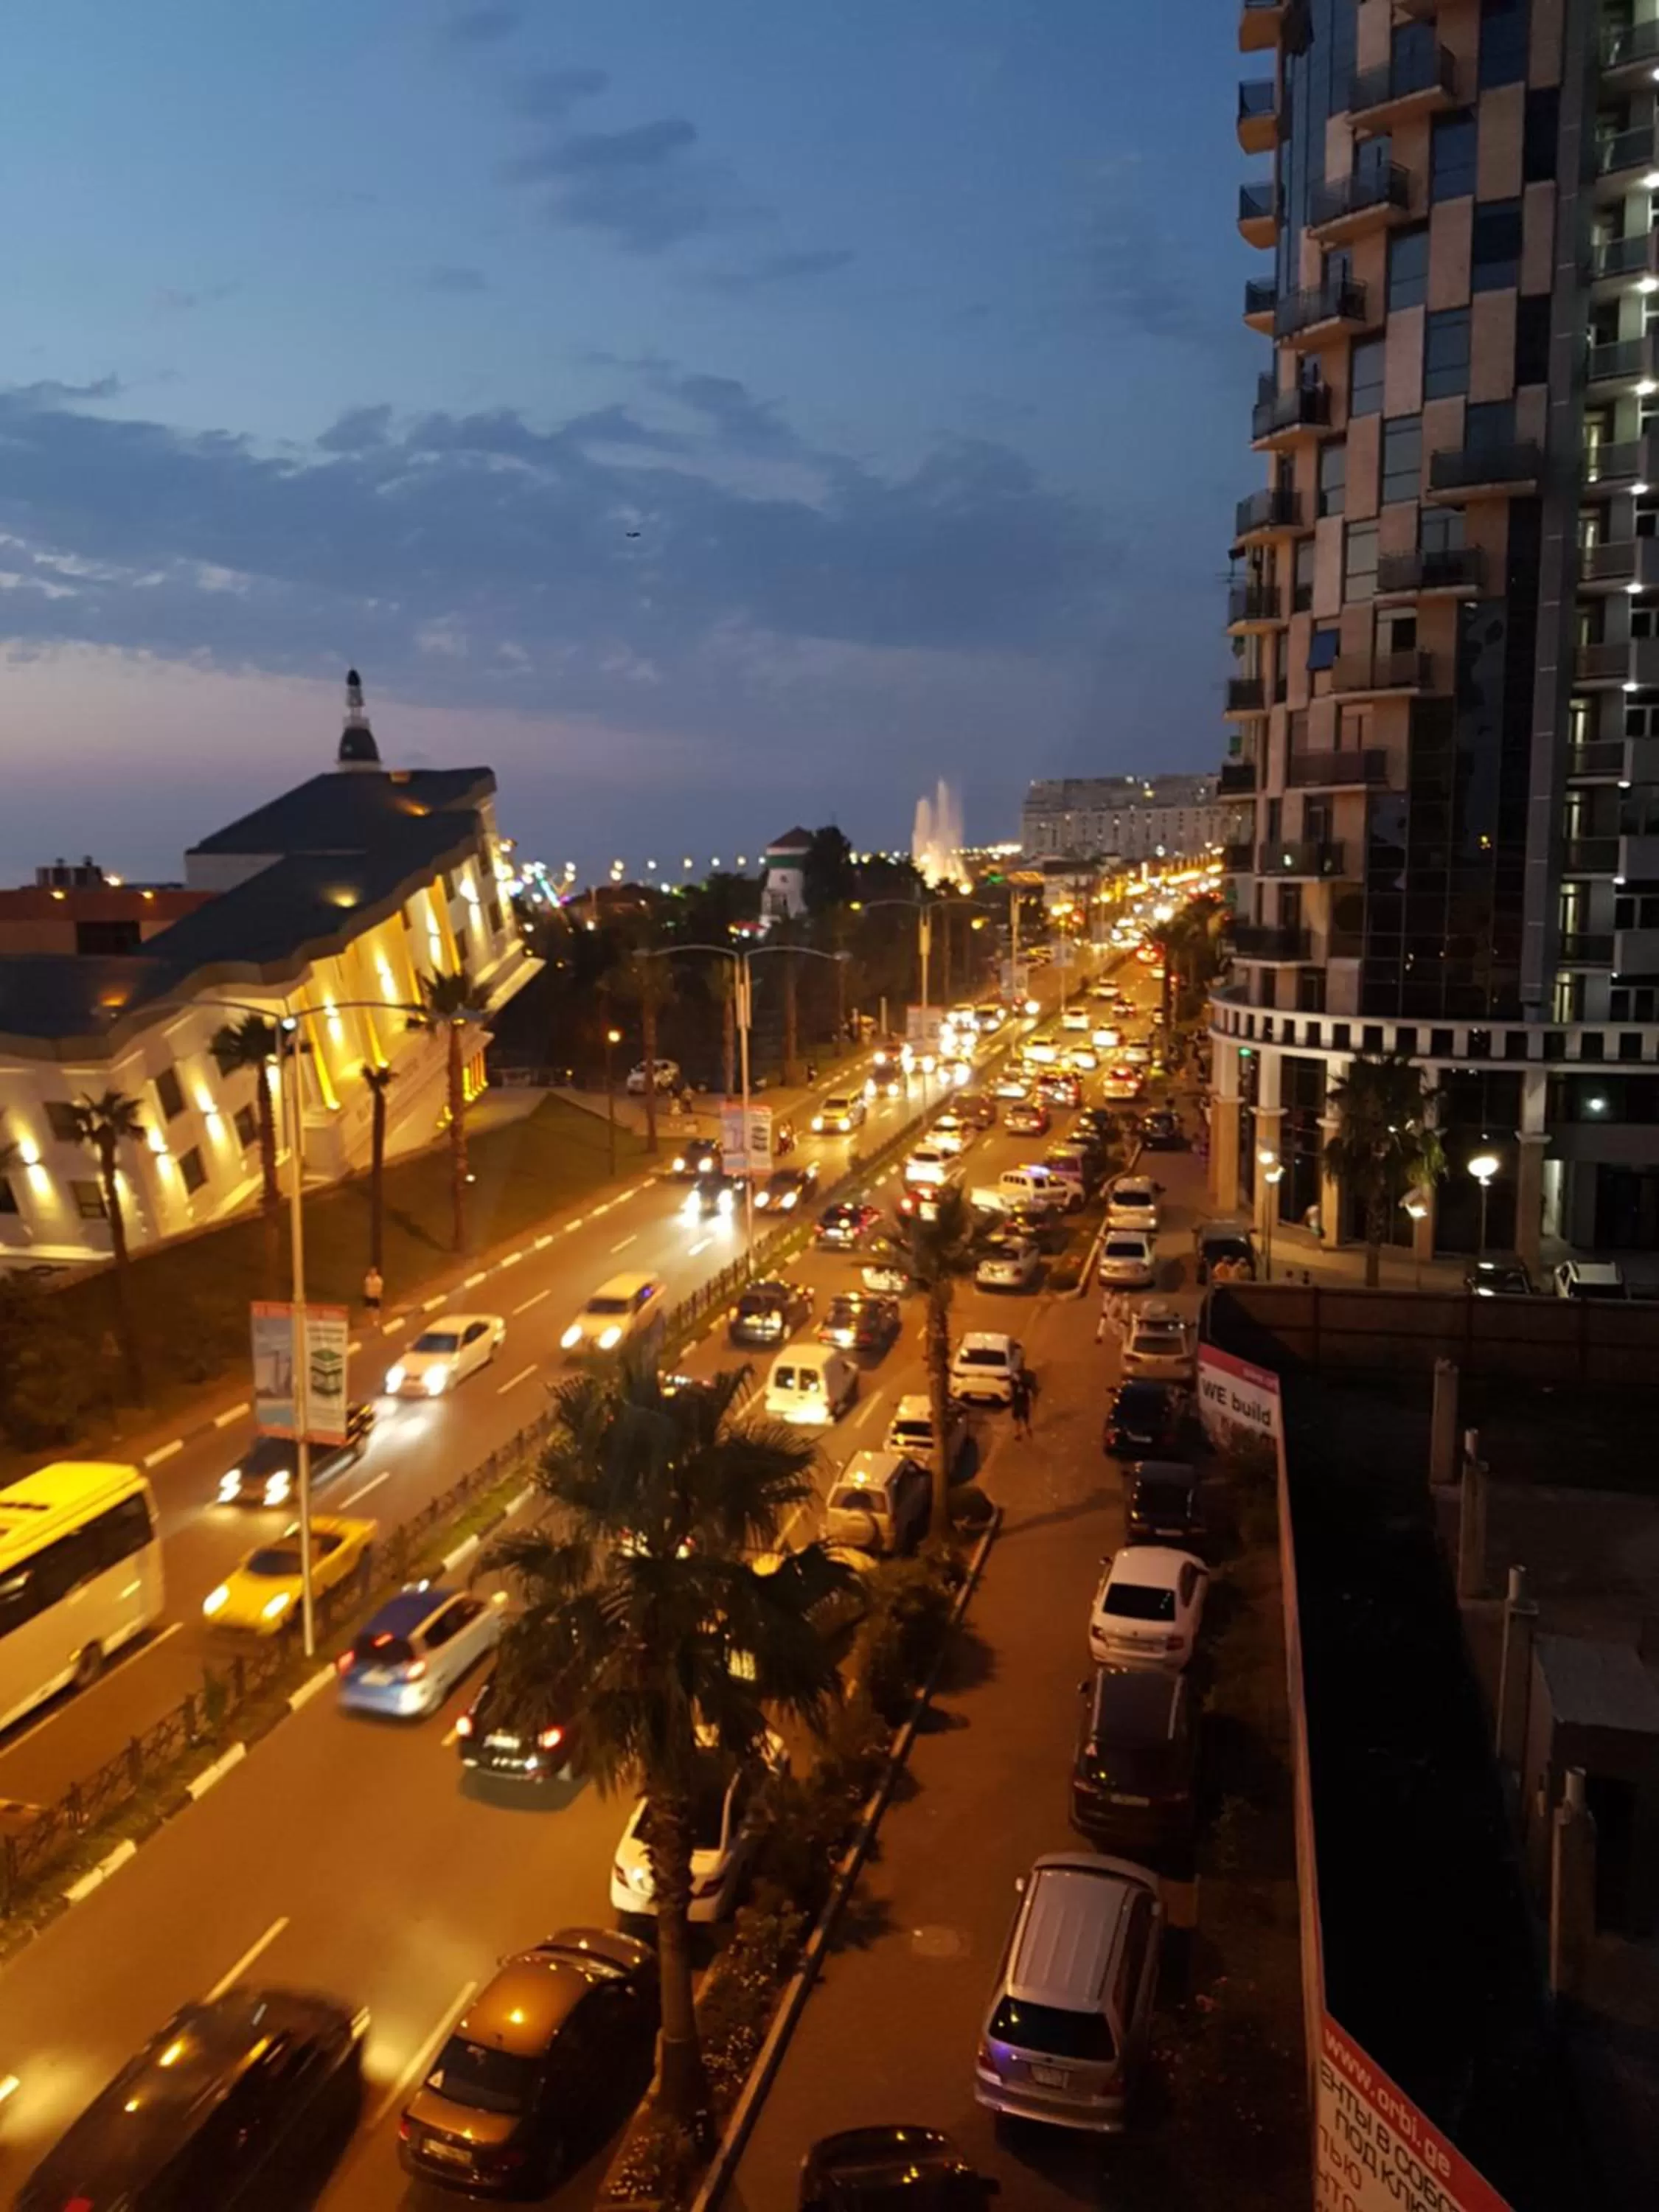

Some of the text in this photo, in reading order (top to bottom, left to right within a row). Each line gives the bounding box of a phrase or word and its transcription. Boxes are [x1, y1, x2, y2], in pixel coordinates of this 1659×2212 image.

[1202, 1378, 1227, 1405] WE
[1231, 1392, 1271, 1426] build
[1325, 2029, 1451, 2178] www.orbi.ge
